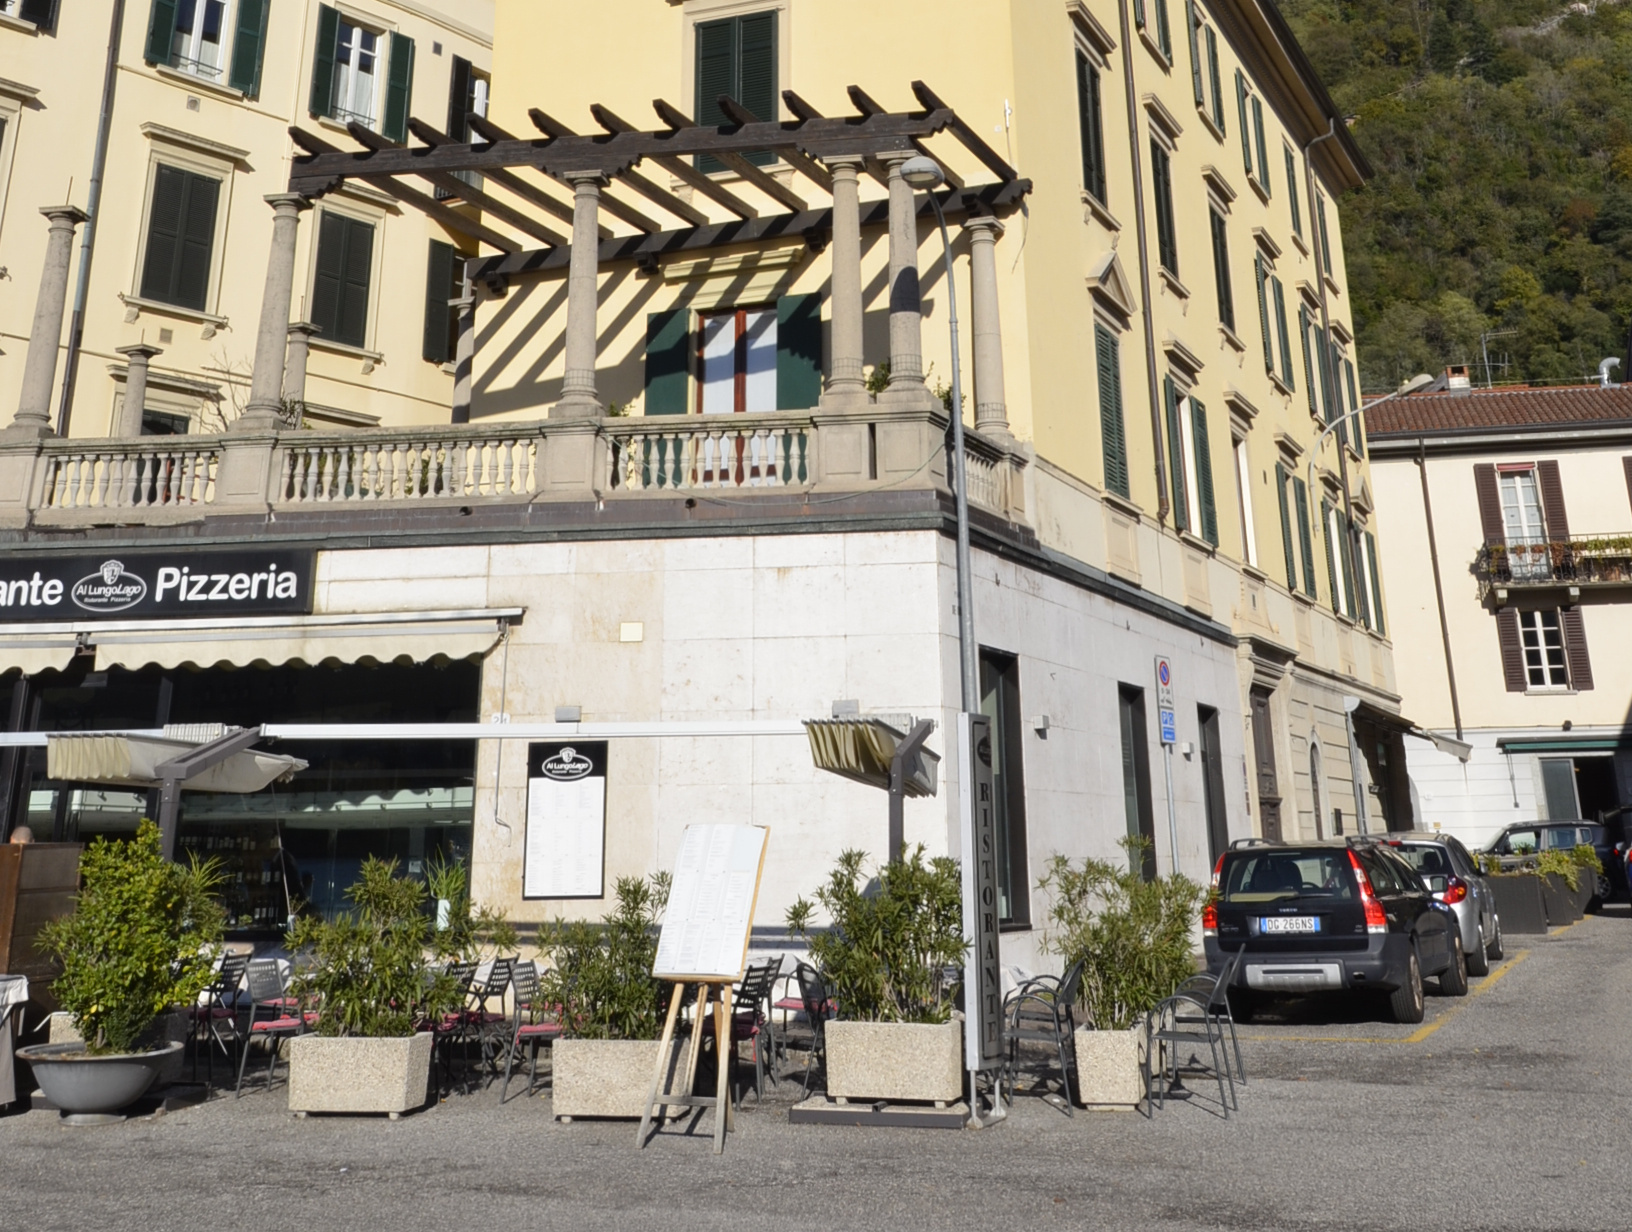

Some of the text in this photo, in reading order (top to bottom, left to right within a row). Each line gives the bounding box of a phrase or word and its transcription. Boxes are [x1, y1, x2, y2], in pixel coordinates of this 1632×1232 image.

[76, 583, 142, 598] Al LungoLago
[155, 563, 297, 602] Pizzeria
[980, 782, 997, 1043] RISTORANTE
[1283, 917, 1313, 930] 266NS
